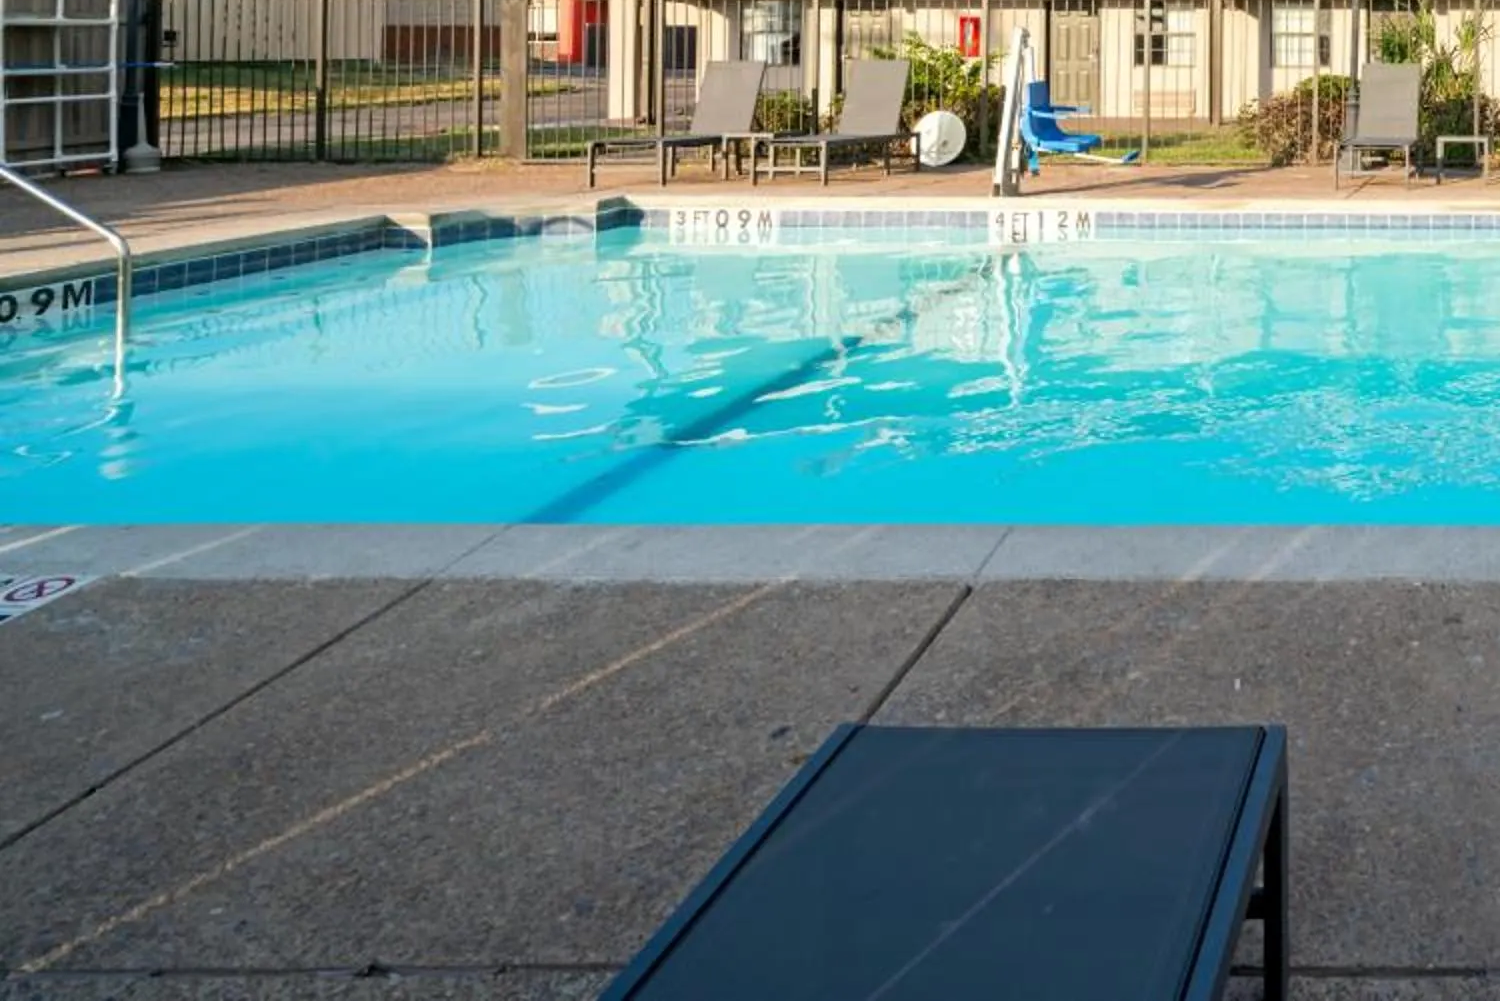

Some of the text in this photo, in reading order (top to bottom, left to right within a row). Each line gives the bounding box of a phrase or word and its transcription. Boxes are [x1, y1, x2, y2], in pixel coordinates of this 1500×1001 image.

[676, 211, 686, 226] 3
[757, 209, 772, 229] M
[1076, 212, 1090, 230] M
